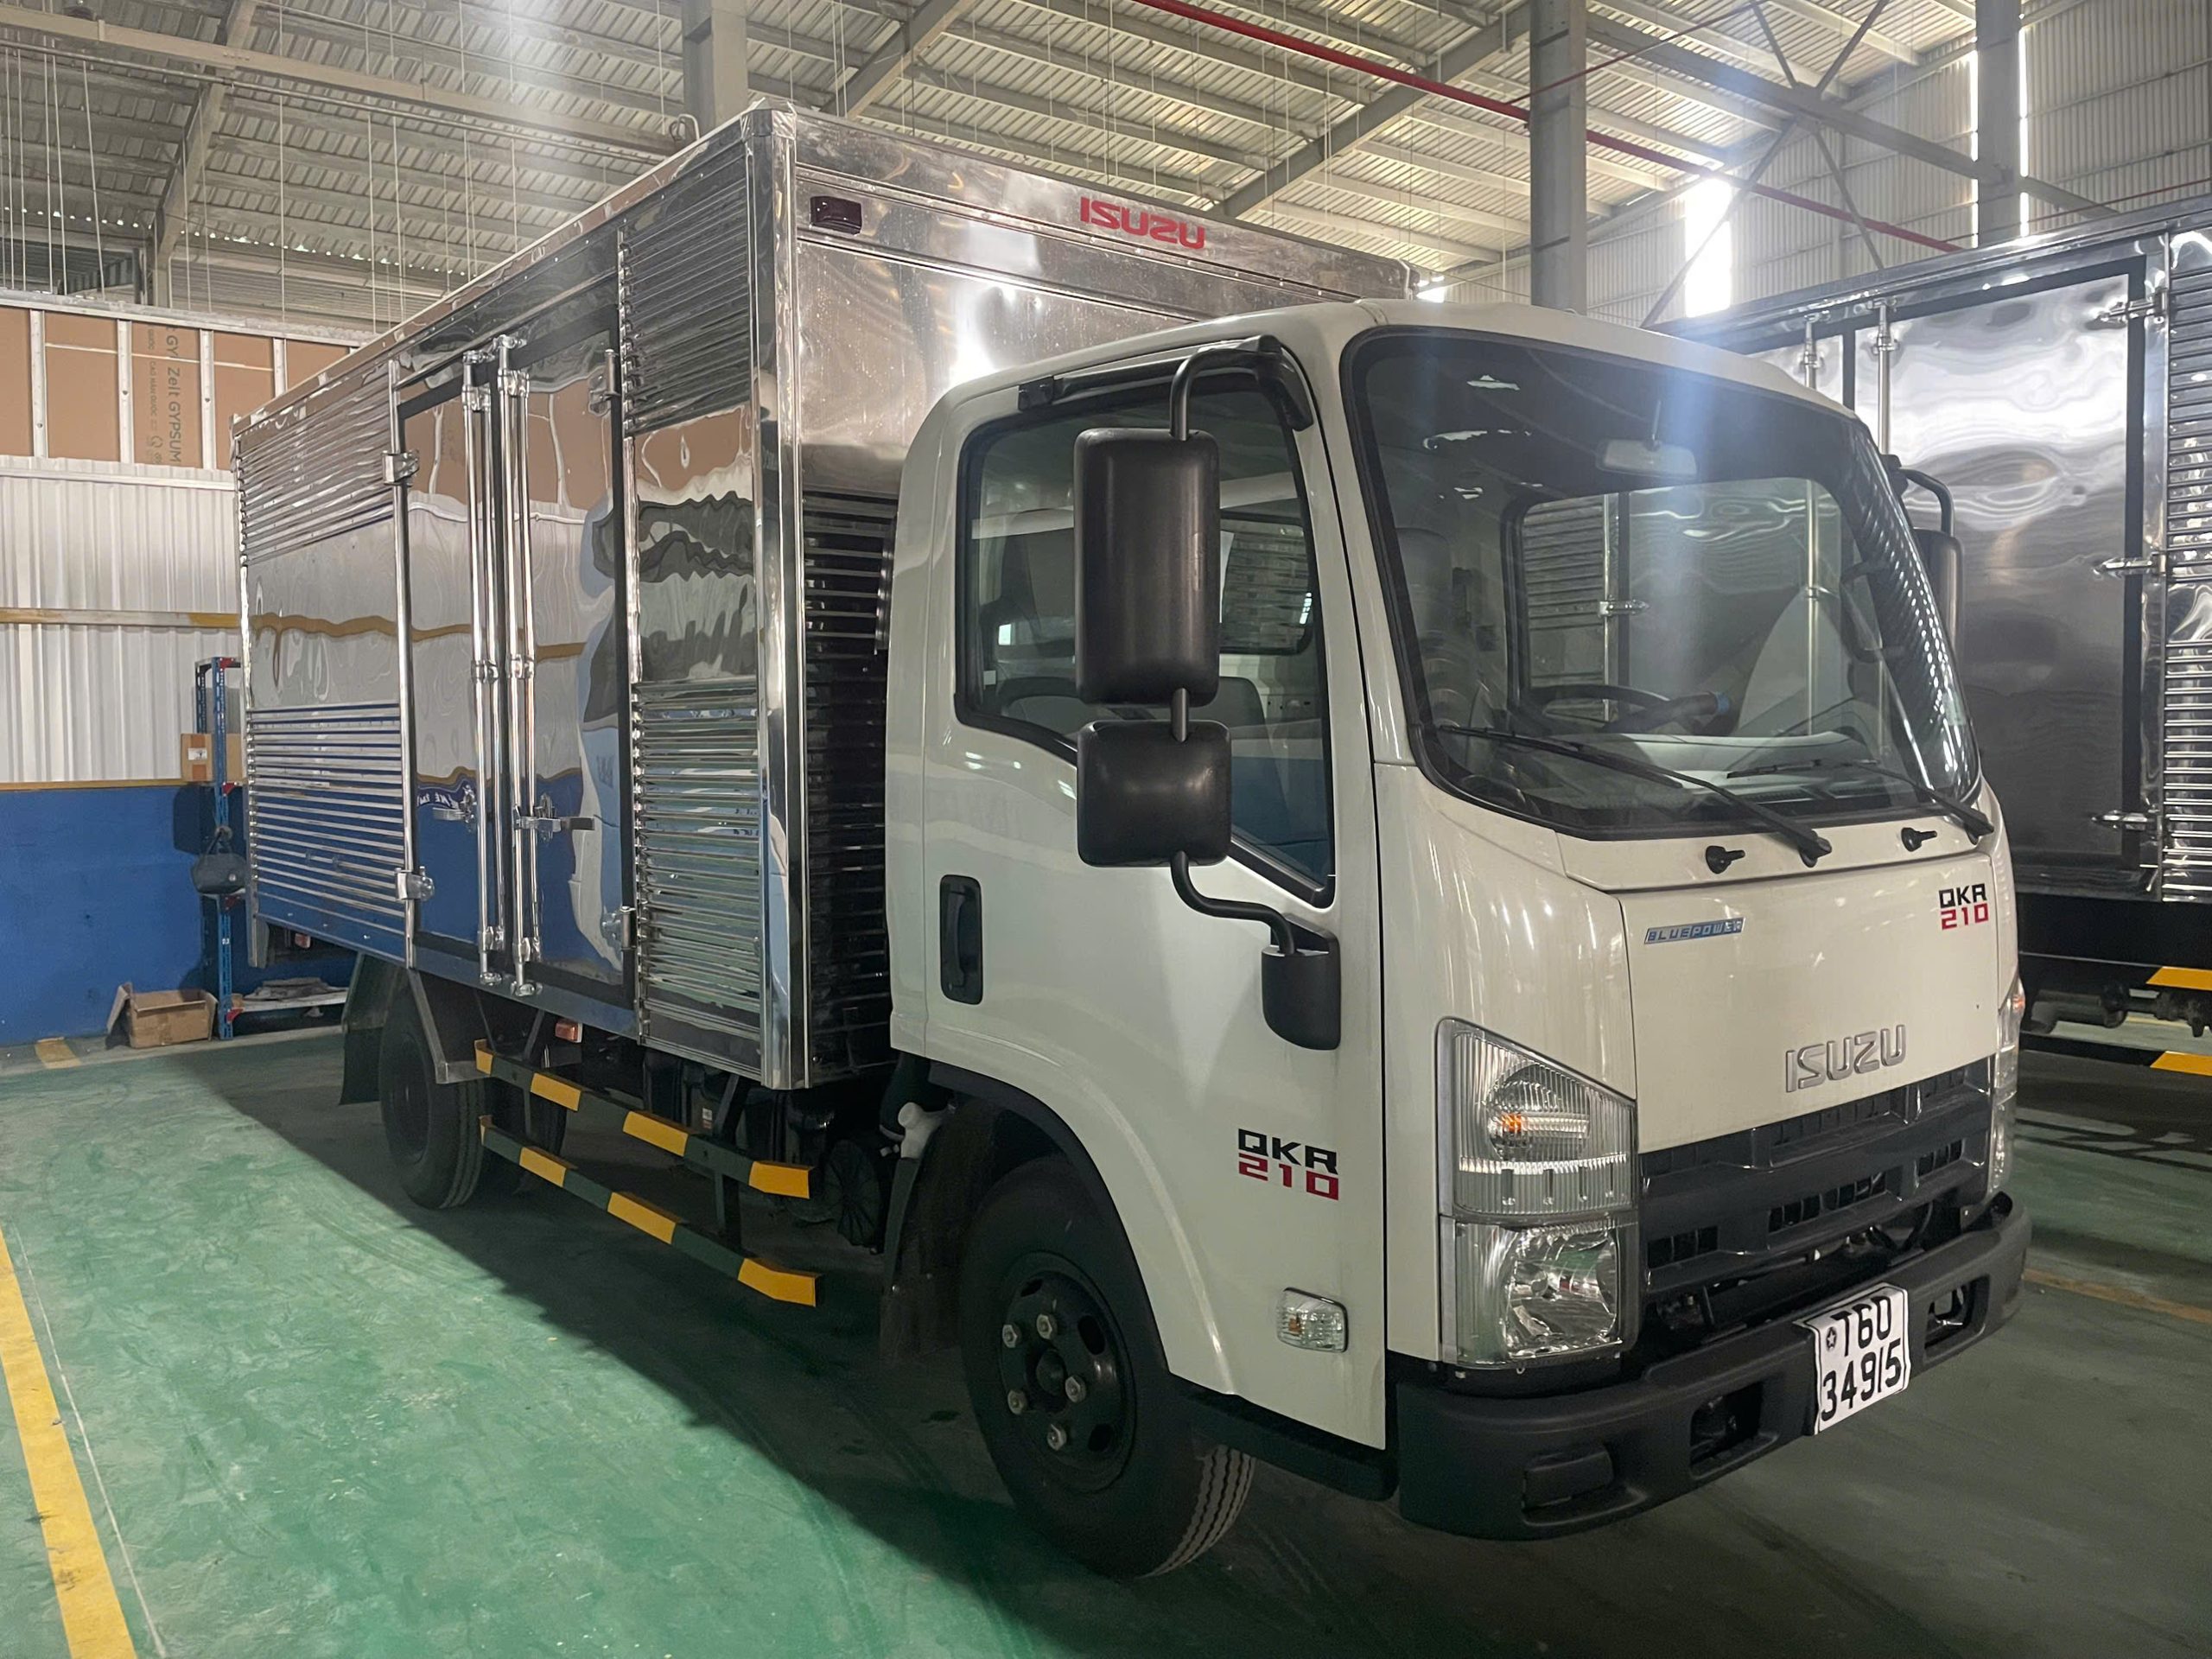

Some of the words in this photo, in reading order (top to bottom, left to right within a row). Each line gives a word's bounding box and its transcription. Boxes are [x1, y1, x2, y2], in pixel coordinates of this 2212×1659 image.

[1080, 196, 1205, 249] ISUZU
[168, 401, 181, 462] GYPSUM
[1939, 883, 1987, 908] QKR
[1941, 903, 1988, 930] 210
[1647, 919, 1743, 942] BLUEPOWER
[1786, 1025, 1906, 1092] ISUZU
[1238, 1128, 1338, 1175] QKR
[1239, 1153, 1338, 1200] 210
[1830, 1296, 1892, 1357] T60
[1821, 1338, 1903, 1422] 34915
